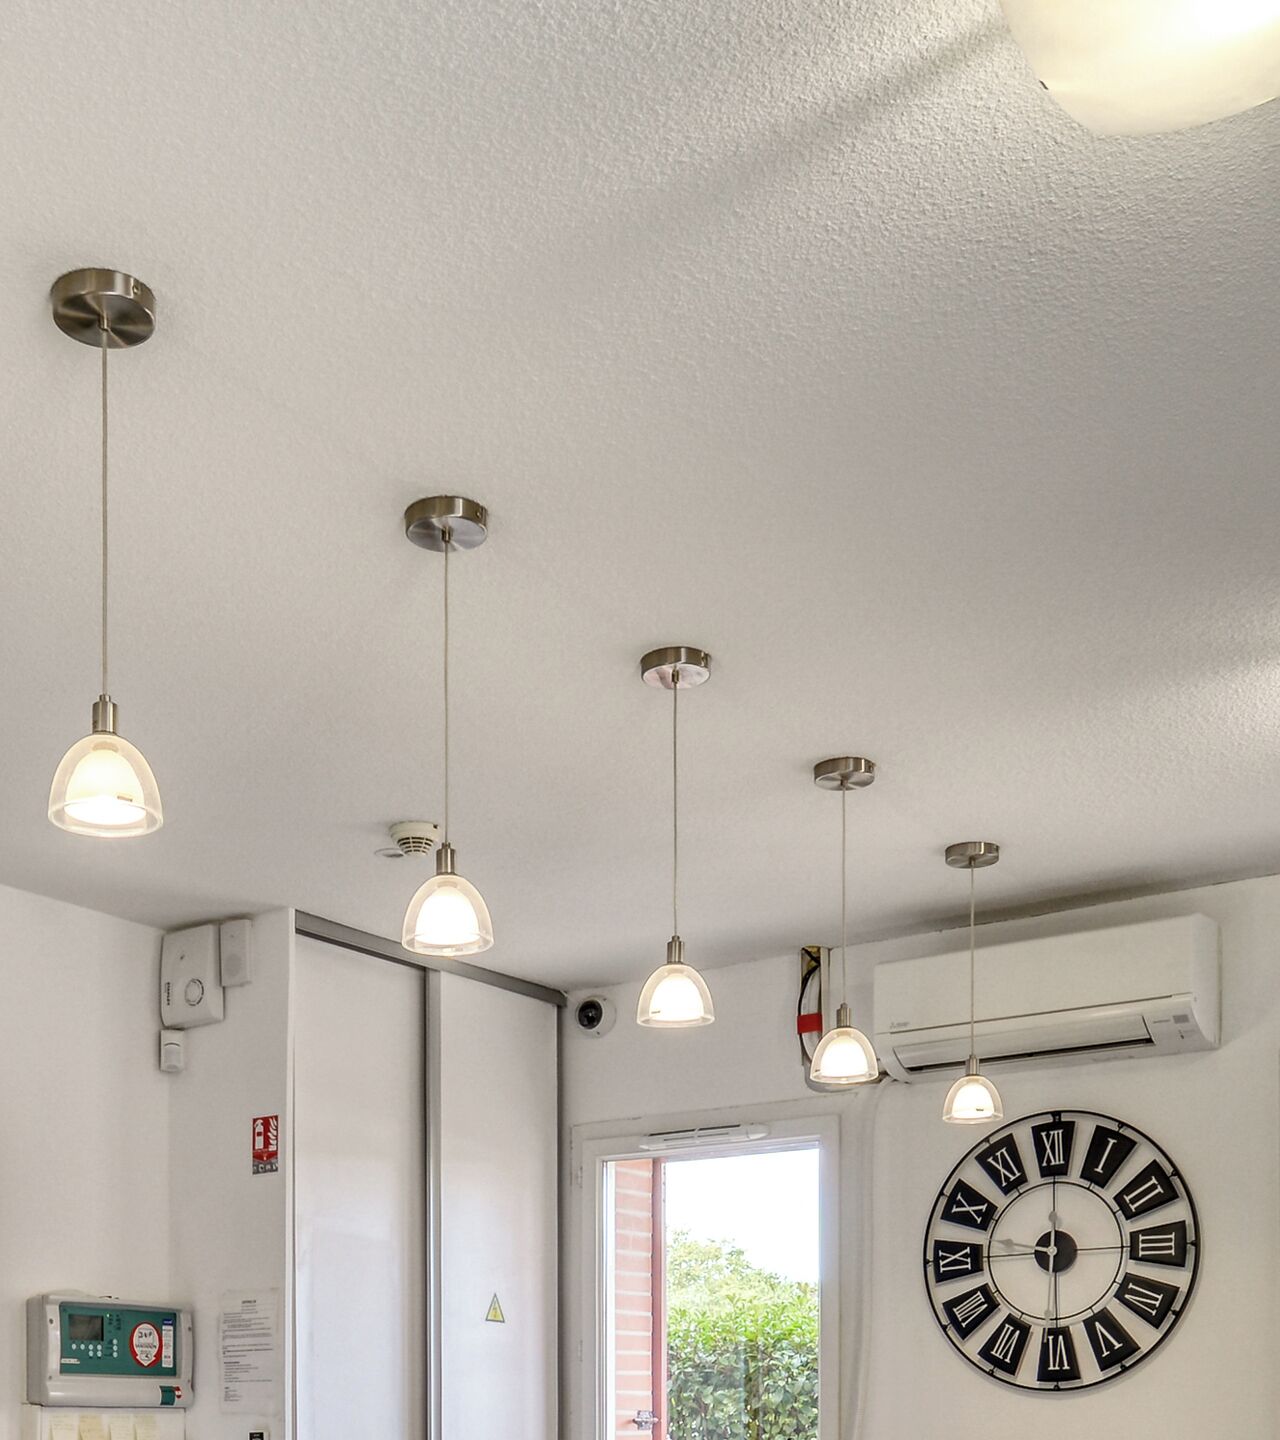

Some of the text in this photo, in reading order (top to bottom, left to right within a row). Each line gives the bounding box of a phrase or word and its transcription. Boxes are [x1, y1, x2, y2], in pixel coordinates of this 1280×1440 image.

[1041, 1129, 1065, 1166] XII
[1094, 1137, 1117, 1173] I
[987, 1147, 1022, 1187] XI
[951, 1192, 989, 1224] X
[1123, 1175, 1165, 1212] II
[938, 1246, 972, 1273] IX
[1139, 1232, 1175, 1256] III
[953, 1290, 989, 1328] VIII
[1124, 1283, 1164, 1316] IV
[990, 1324, 1019, 1363] VII
[1047, 1334, 1070, 1371] VI
[1095, 1322, 1122, 1357] V
